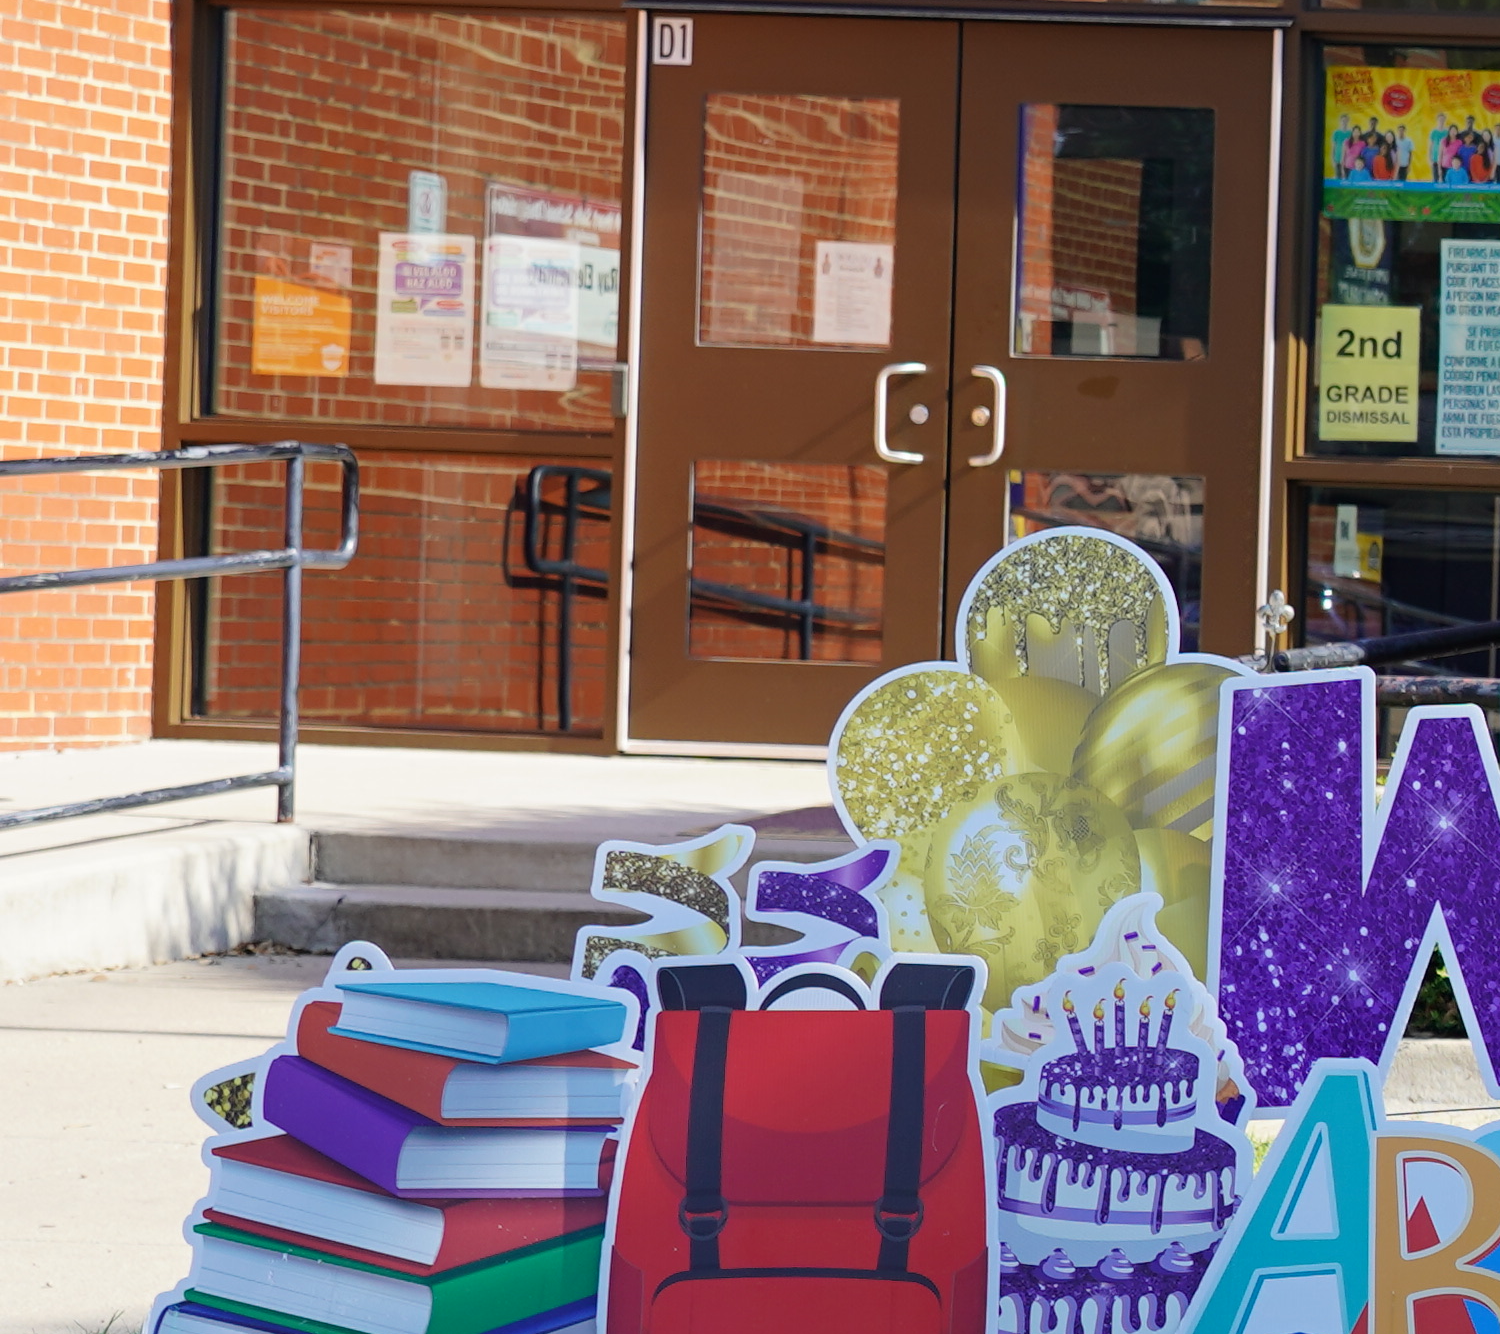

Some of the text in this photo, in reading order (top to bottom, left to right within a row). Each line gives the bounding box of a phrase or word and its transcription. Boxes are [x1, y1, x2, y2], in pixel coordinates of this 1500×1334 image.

[660, 23, 687, 59] D1
[1448, 247, 1487, 259] FIREARMS
[1453, 290, 1483, 301] PERSON
[1336, 329, 1402, 359] 2nd
[1476, 371, 1500, 382] PENAL
[1326, 385, 1409, 404] GRADE
[1486, 385, 1500, 395] LAS
[1327, 411, 1410, 425] DISMISSAL
[1442, 426, 1461, 437] ESTA
